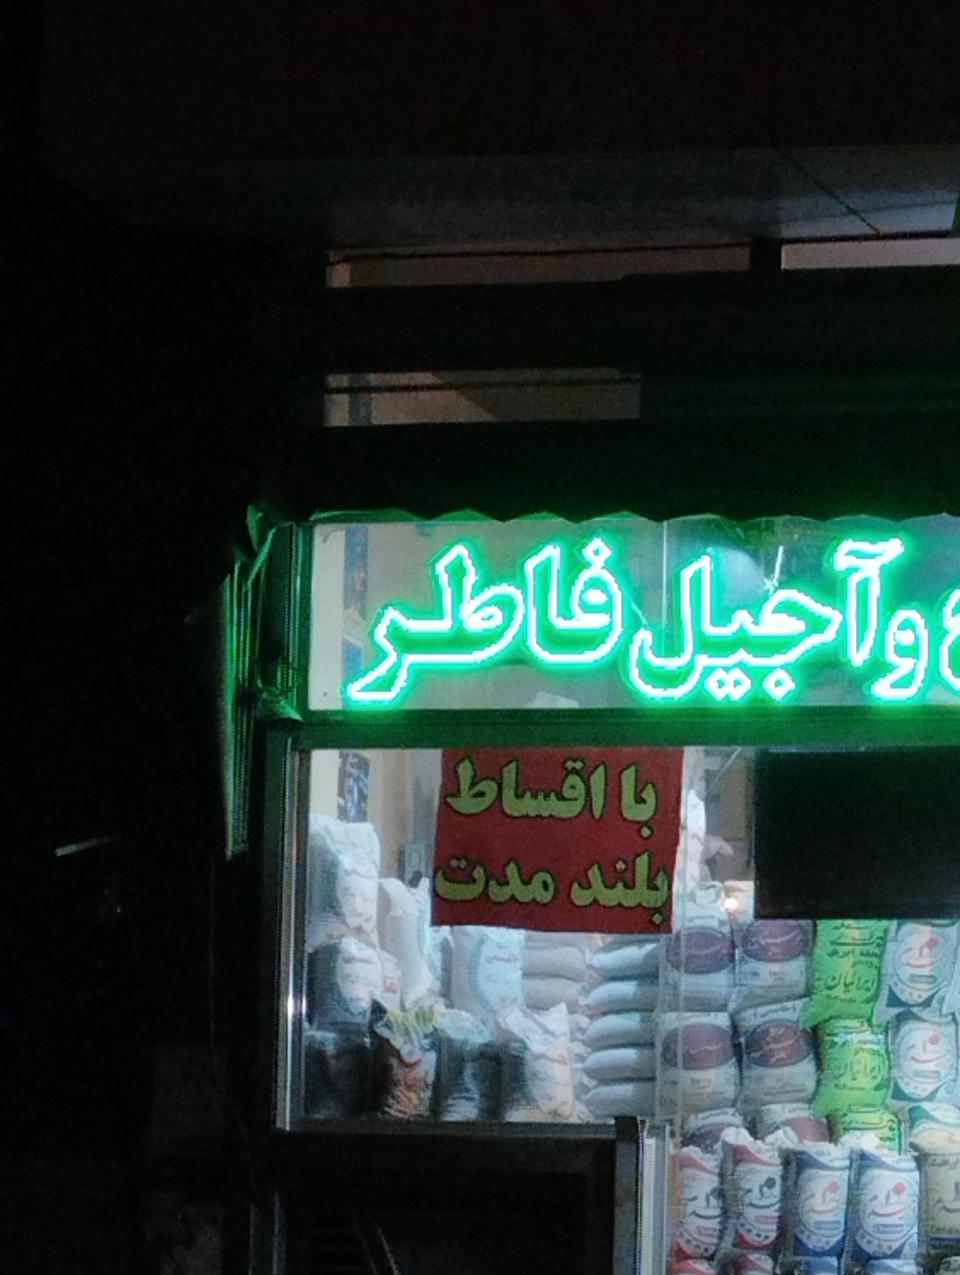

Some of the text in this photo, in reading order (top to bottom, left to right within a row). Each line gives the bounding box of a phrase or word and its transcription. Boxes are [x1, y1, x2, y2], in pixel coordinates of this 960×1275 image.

[345, 537, 623, 703] فاطر
[628, 538, 905, 701] آجیل
[871, 608, 929, 699] و
[445, 756, 658, 838] با اقساط
[434, 851, 671, 926] بلند مدت
